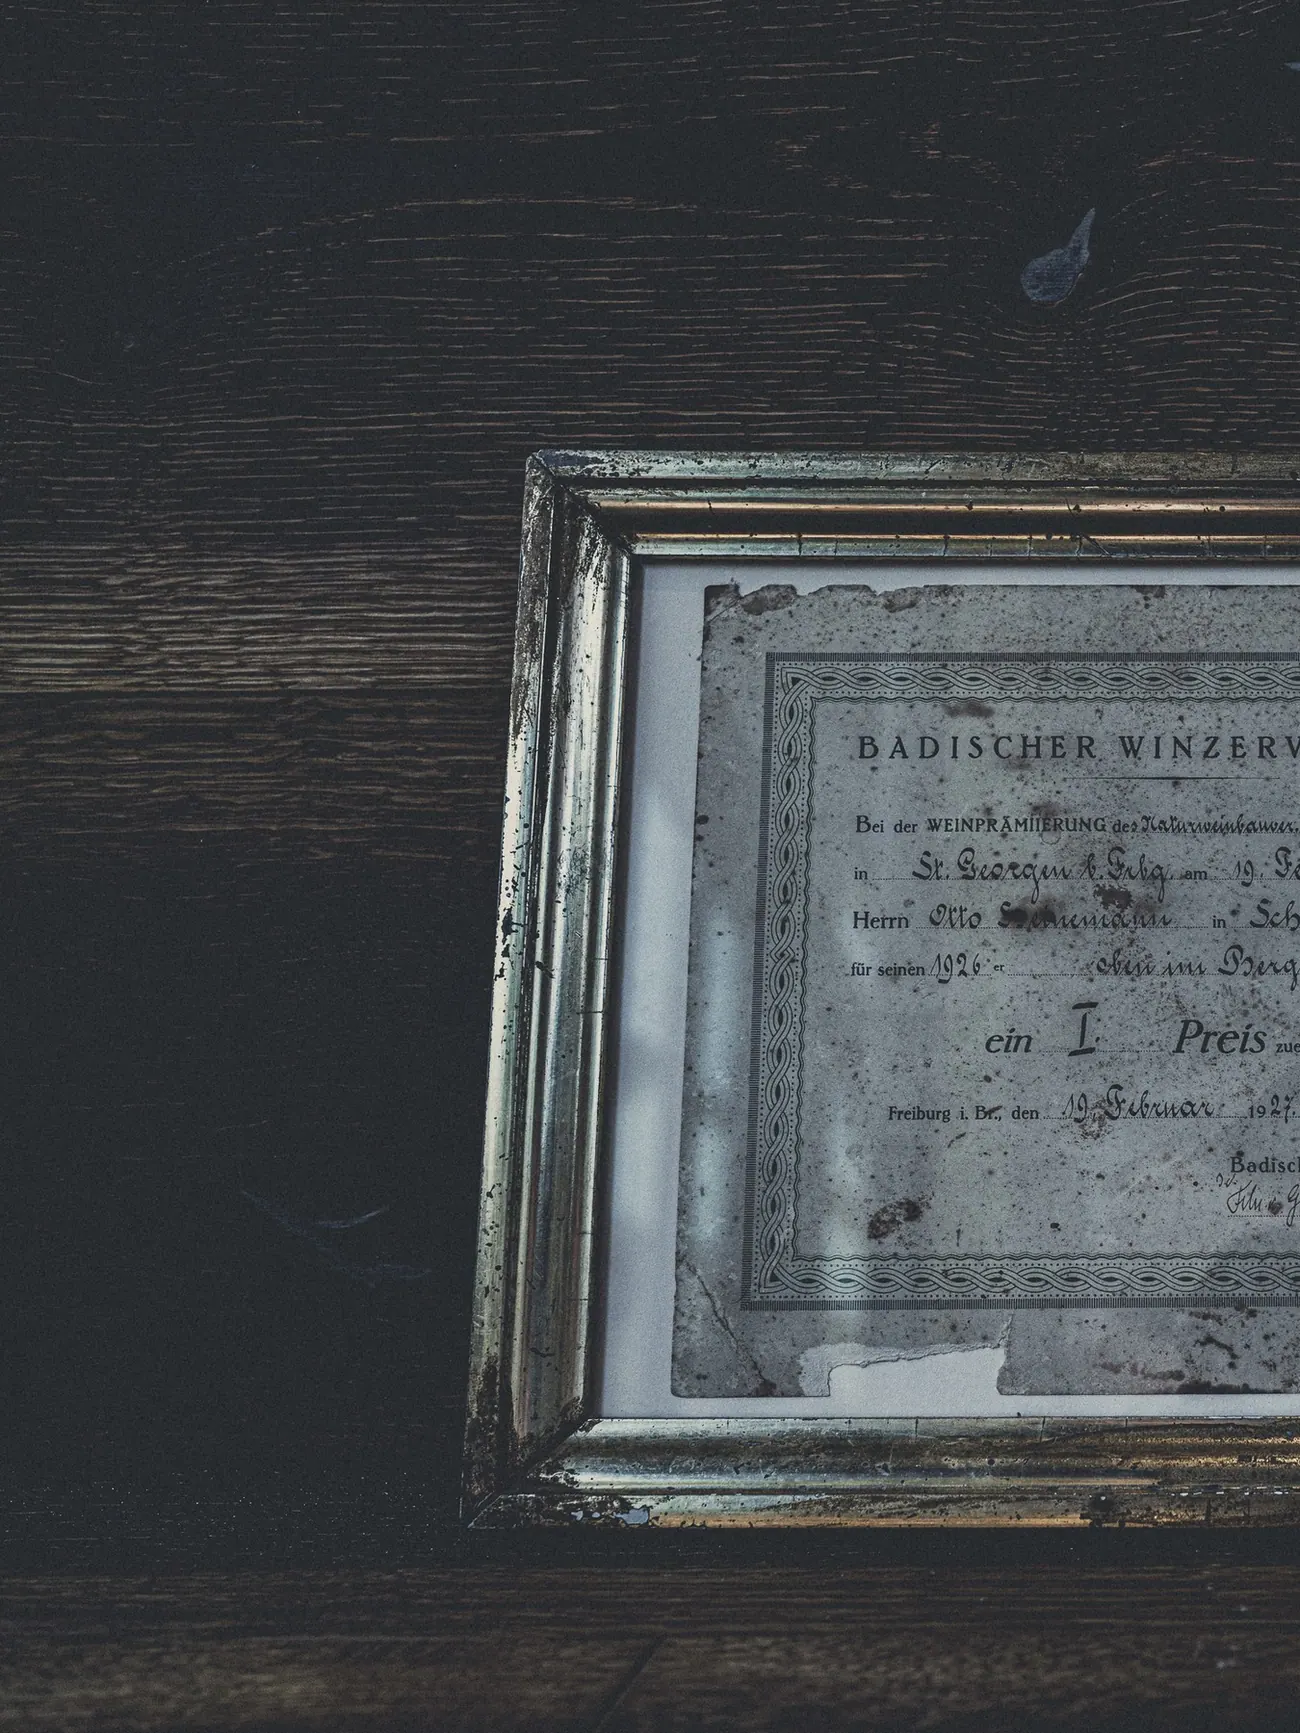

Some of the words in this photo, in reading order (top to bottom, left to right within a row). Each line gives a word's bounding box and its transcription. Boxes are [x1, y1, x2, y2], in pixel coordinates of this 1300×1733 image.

[858, 735, 1097, 760] BADISCHER
[855, 814, 885, 834] Bei
[893, 817, 919, 834] der
[854, 866, 869, 881] in
[957, 847, 1072, 902] Georgen
[1184, 868, 1208, 881] am
[852, 911, 909, 930] Herrn
[928, 903, 983, 930] Otto
[1212, 915, 1226, 930] in
[850, 961, 872, 978] für
[877, 963, 926, 978] seinen
[984, 1027, 1033, 1054] ein
[1172, 1019, 1268, 1054] Preis
[888, 1105, 951, 1124] Freiburg
[959, 1107, 969, 1121] i.
[1011, 1106, 1040, 1121] den
[1105, 1083, 1215, 1121] Februar
